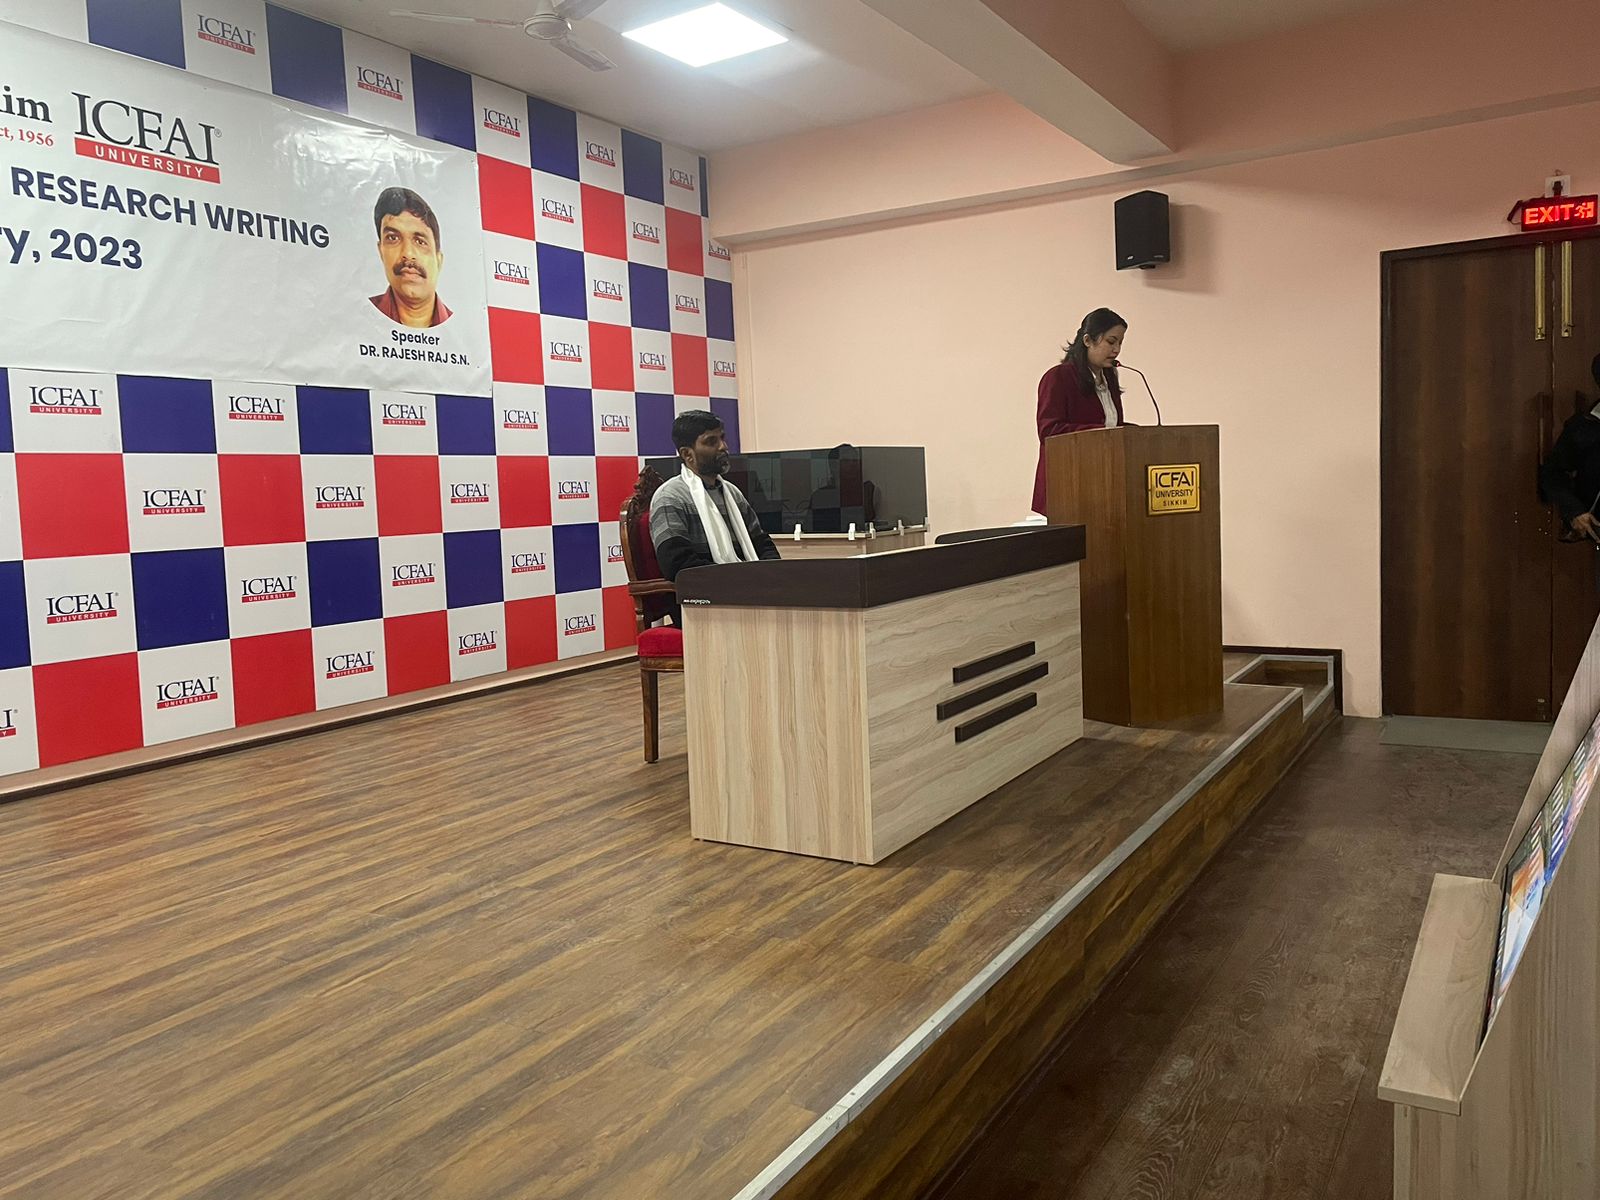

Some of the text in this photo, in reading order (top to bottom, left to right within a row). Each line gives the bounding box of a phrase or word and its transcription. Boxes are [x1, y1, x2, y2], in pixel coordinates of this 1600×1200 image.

[198, 15, 253, 46] ICFAI
[357, 66, 401, 93] ICFAI
[0, 85, 53, 123] im
[483, 108, 518, 130] ICFAI
[72, 92, 219, 165] ICFAI
[19, 129, 54, 146] 1956
[586, 142, 614, 161] ICFAI
[95, 145, 204, 178] UNIVERSITY
[11, 166, 330, 248] RESEARCH WRITING
[541, 198, 573, 218] ICFAI
[1525, 204, 1574, 224] EXIT
[632, 221, 658, 238] ICFAI
[0, 227, 142, 270] y, 2023
[494, 260, 528, 278] ICFAI
[594, 280, 622, 296] ICFAI
[675, 294, 698, 308] ICFAI
[392, 330, 440, 345] Speaker
[360, 344, 470, 365] DR. RAJESH RAJ S.N.
[550, 342, 581, 358] ICFAI
[640, 352, 665, 366] ICFAI
[714, 361, 735, 373] ICFAI
[29, 386, 98, 407] ICFAI
[229, 396, 282, 414] ICFAI
[382, 404, 424, 419] ICFAI
[504, 410, 537, 424] ICFAI
[601, 414, 629, 427] ICFAI
[558, 481, 588, 494] ICFAI
[1156, 471, 1194, 488] ICFAI
[143, 489, 203, 508] ICFAI
[316, 486, 362, 502] ICFAI
[450, 484, 488, 498] ICFAI
[1156, 489, 1193, 498] UNIVERSITY
[608, 545, 623, 557] ICF
[512, 553, 545, 568] ICFAI
[392, 563, 433, 580] ICFAI
[242, 576, 294, 595] ICFAI
[46, 592, 115, 616] ICFAI
[248, 592, 290, 602] UNIVERSITY
[56, 611, 109, 622] UNIVERSITY
[564, 614, 595, 630] ICFAI
[459, 630, 495, 649] ICFAI
[326, 651, 372, 672] ICFAI
[157, 676, 217, 701] ICFAI
[164, 694, 211, 708] UNIVERSITY
